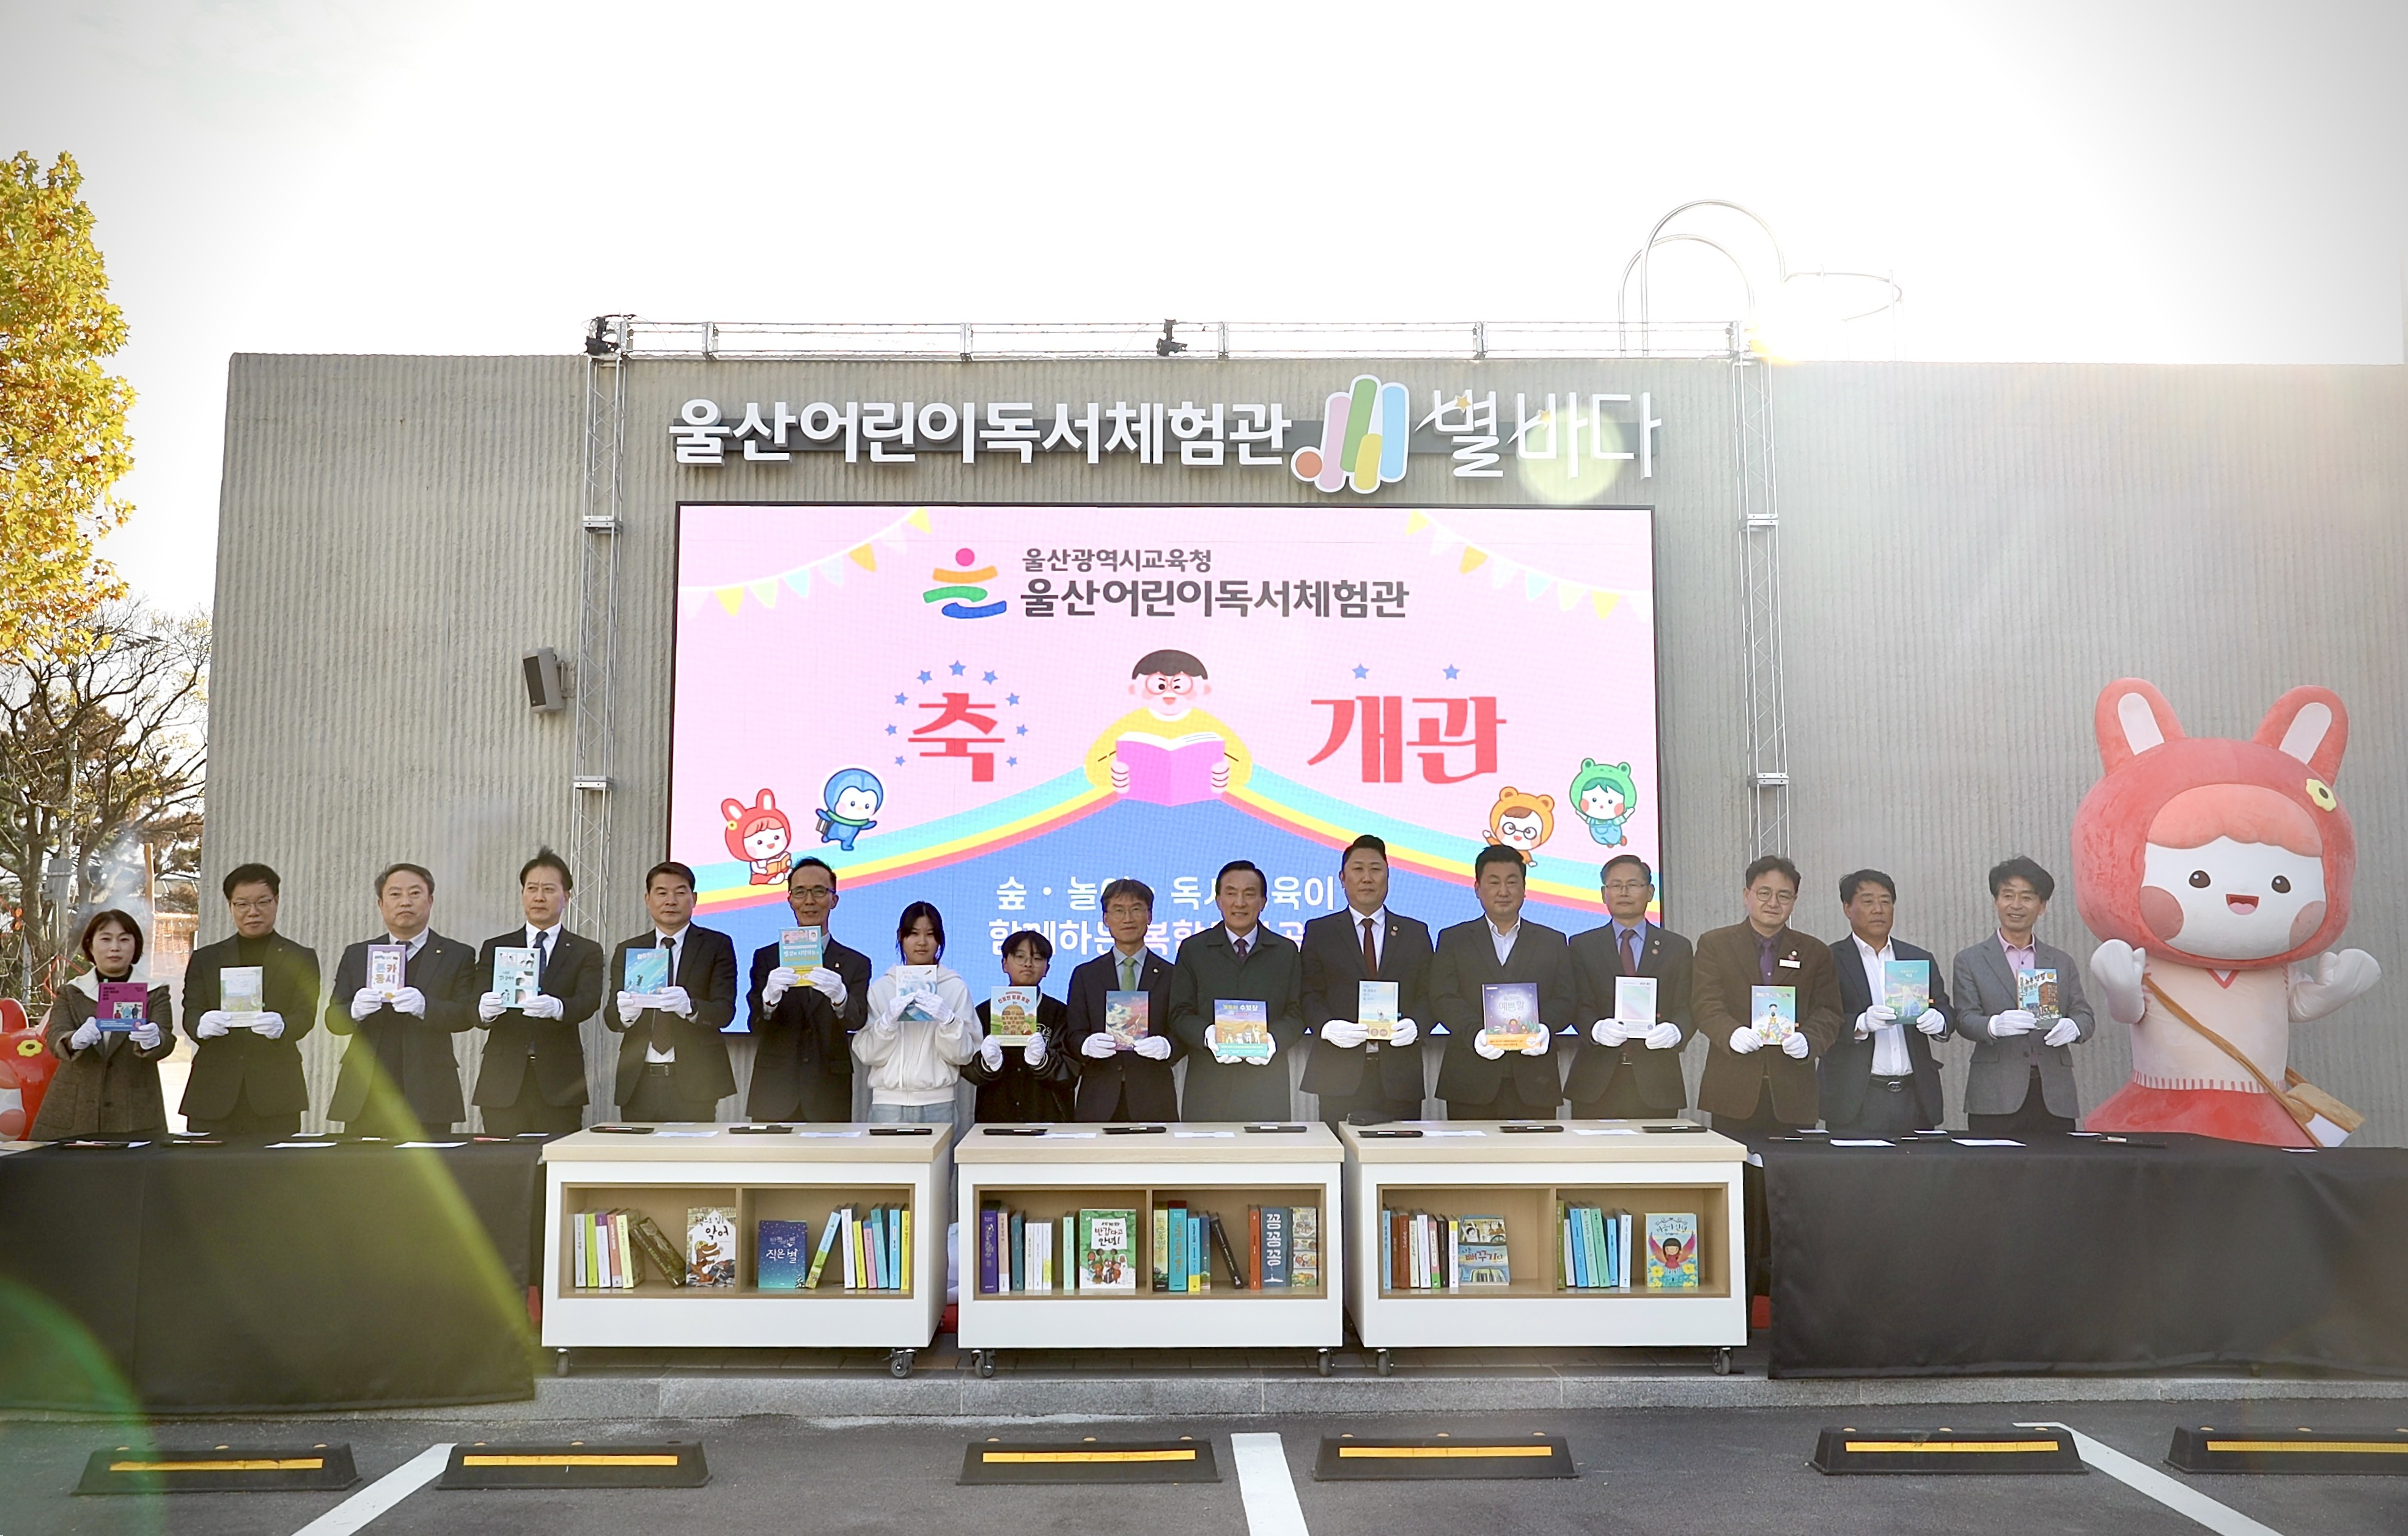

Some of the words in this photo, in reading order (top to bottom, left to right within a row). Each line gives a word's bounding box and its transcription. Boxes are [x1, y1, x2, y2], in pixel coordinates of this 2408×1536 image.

[669, 399, 1292, 466] 울산어린이독서체험관
[1415, 389, 1662, 479] 별바다
[1022, 548, 1211, 573] 울산광역시교육청
[1021, 578, 1410, 618] 울산어린이독서체험관
[908, 693, 1006, 782] 축
[1307, 696, 1507, 785] 개관
[996, 876, 1027, 910] 숲
[1171, 876, 1333, 910] 독육이
[705, 1225, 729, 1240] 악어
[1094, 1227, 1123, 1236] 반갑다고
[1098, 1236, 1120, 1246] 안녕!
[1266, 1213, 1281, 1266] 꽁꽁꽁
[765, 1248, 786, 1261] 작은
[787, 1248, 798, 1263] 별
